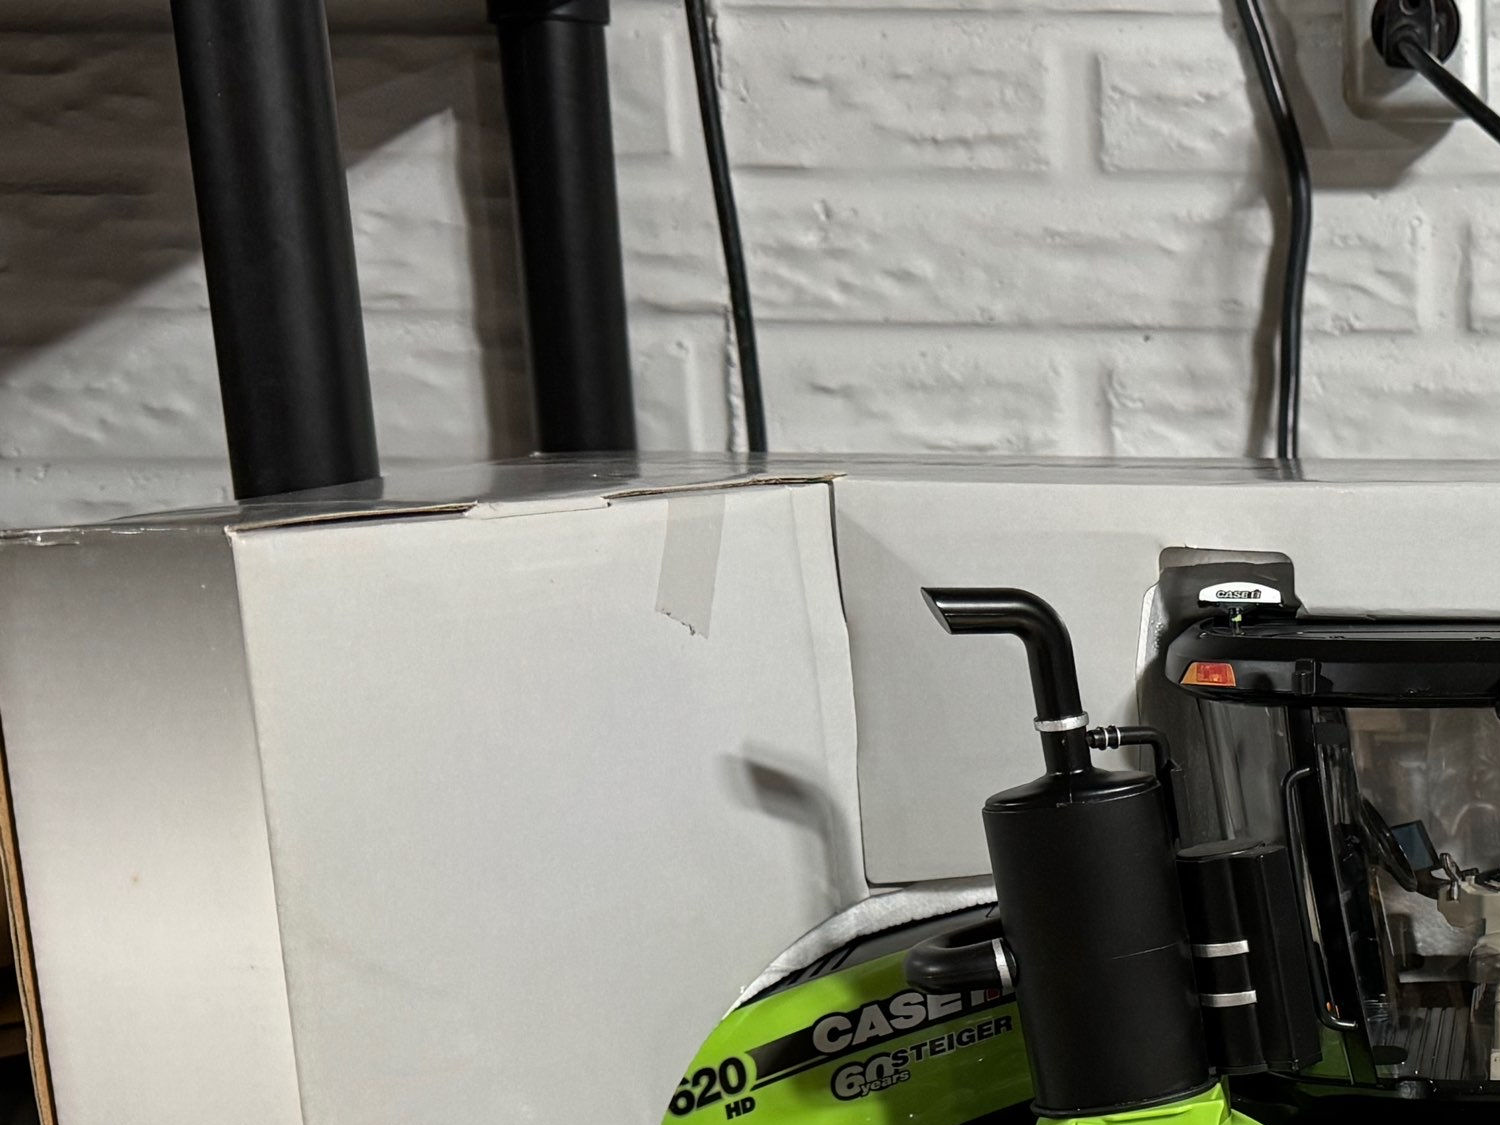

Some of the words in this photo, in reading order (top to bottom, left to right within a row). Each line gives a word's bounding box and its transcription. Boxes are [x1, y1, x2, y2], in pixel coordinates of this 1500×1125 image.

[1216, 590, 1249, 599] CASE
[831, 1050, 899, 1100] 60
[889, 1014, 1014, 1069] STEIGER
[668, 1056, 748, 1117] 620
[860, 1069, 910, 1097] years
[725, 1096, 756, 1121] HD
